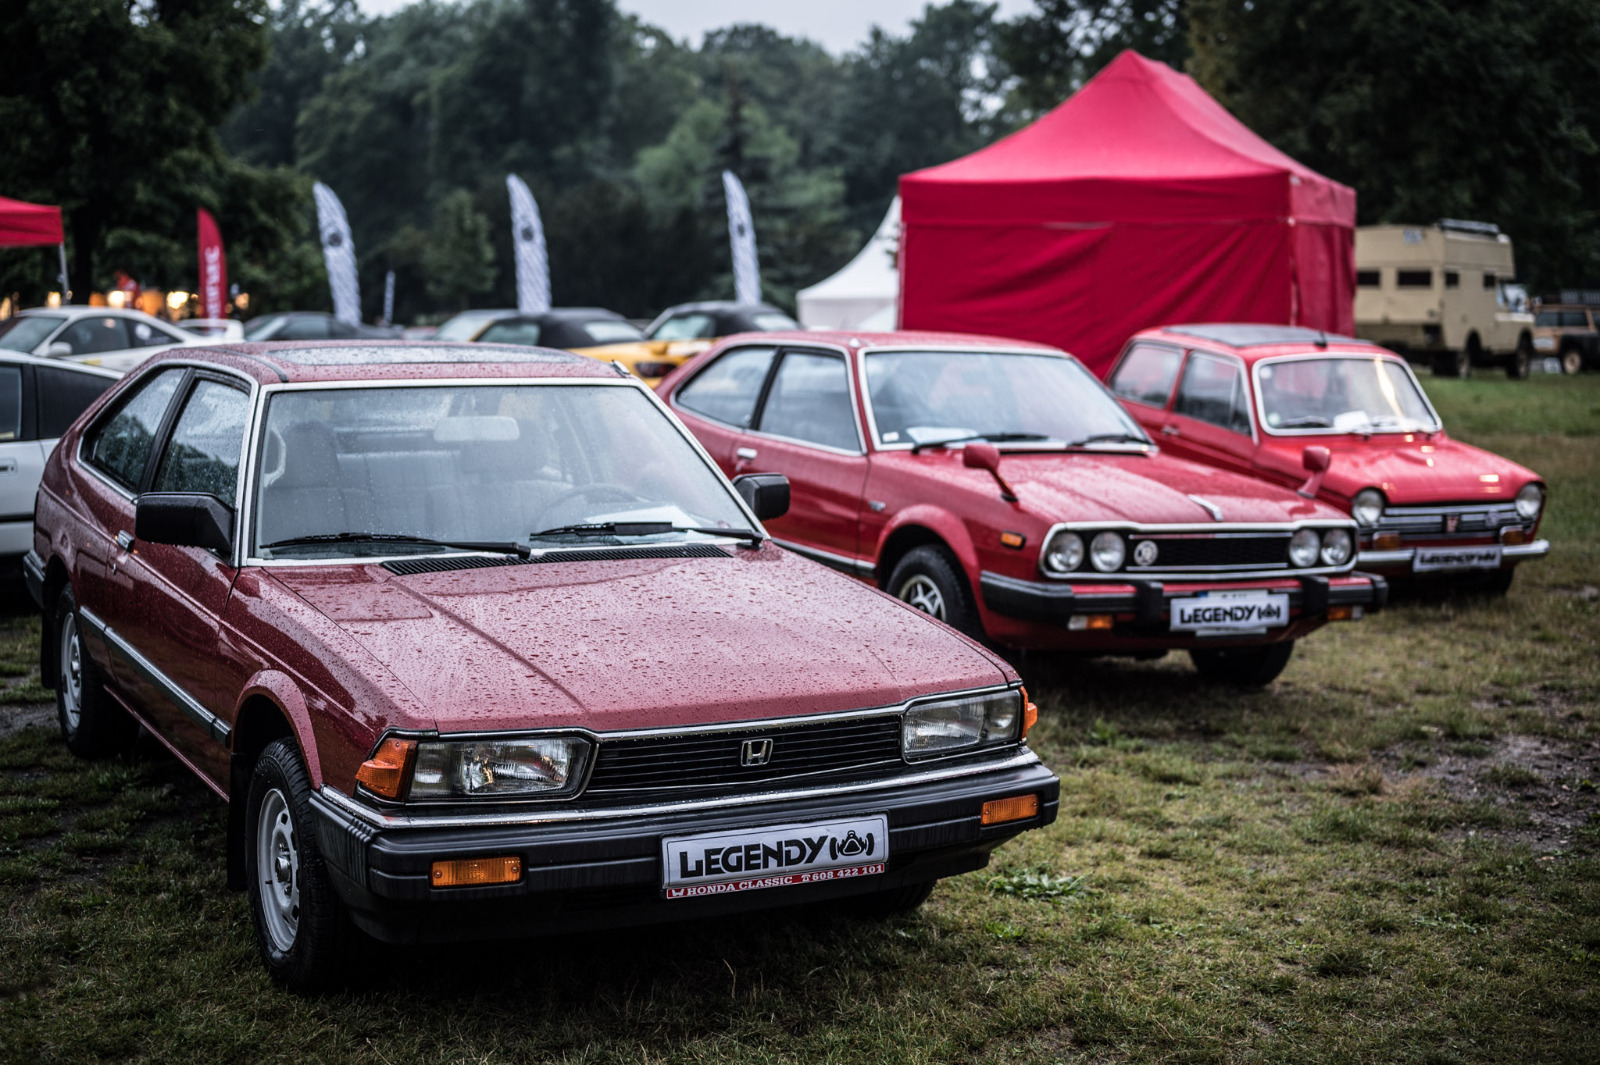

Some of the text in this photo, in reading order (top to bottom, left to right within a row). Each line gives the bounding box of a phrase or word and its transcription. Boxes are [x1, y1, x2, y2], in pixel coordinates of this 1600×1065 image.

[1180, 605, 1256, 624] LEGENDY
[679, 835, 829, 879] LEGENDY
[686, 864, 882, 896] HONDA CLASSIC 608 422 101
